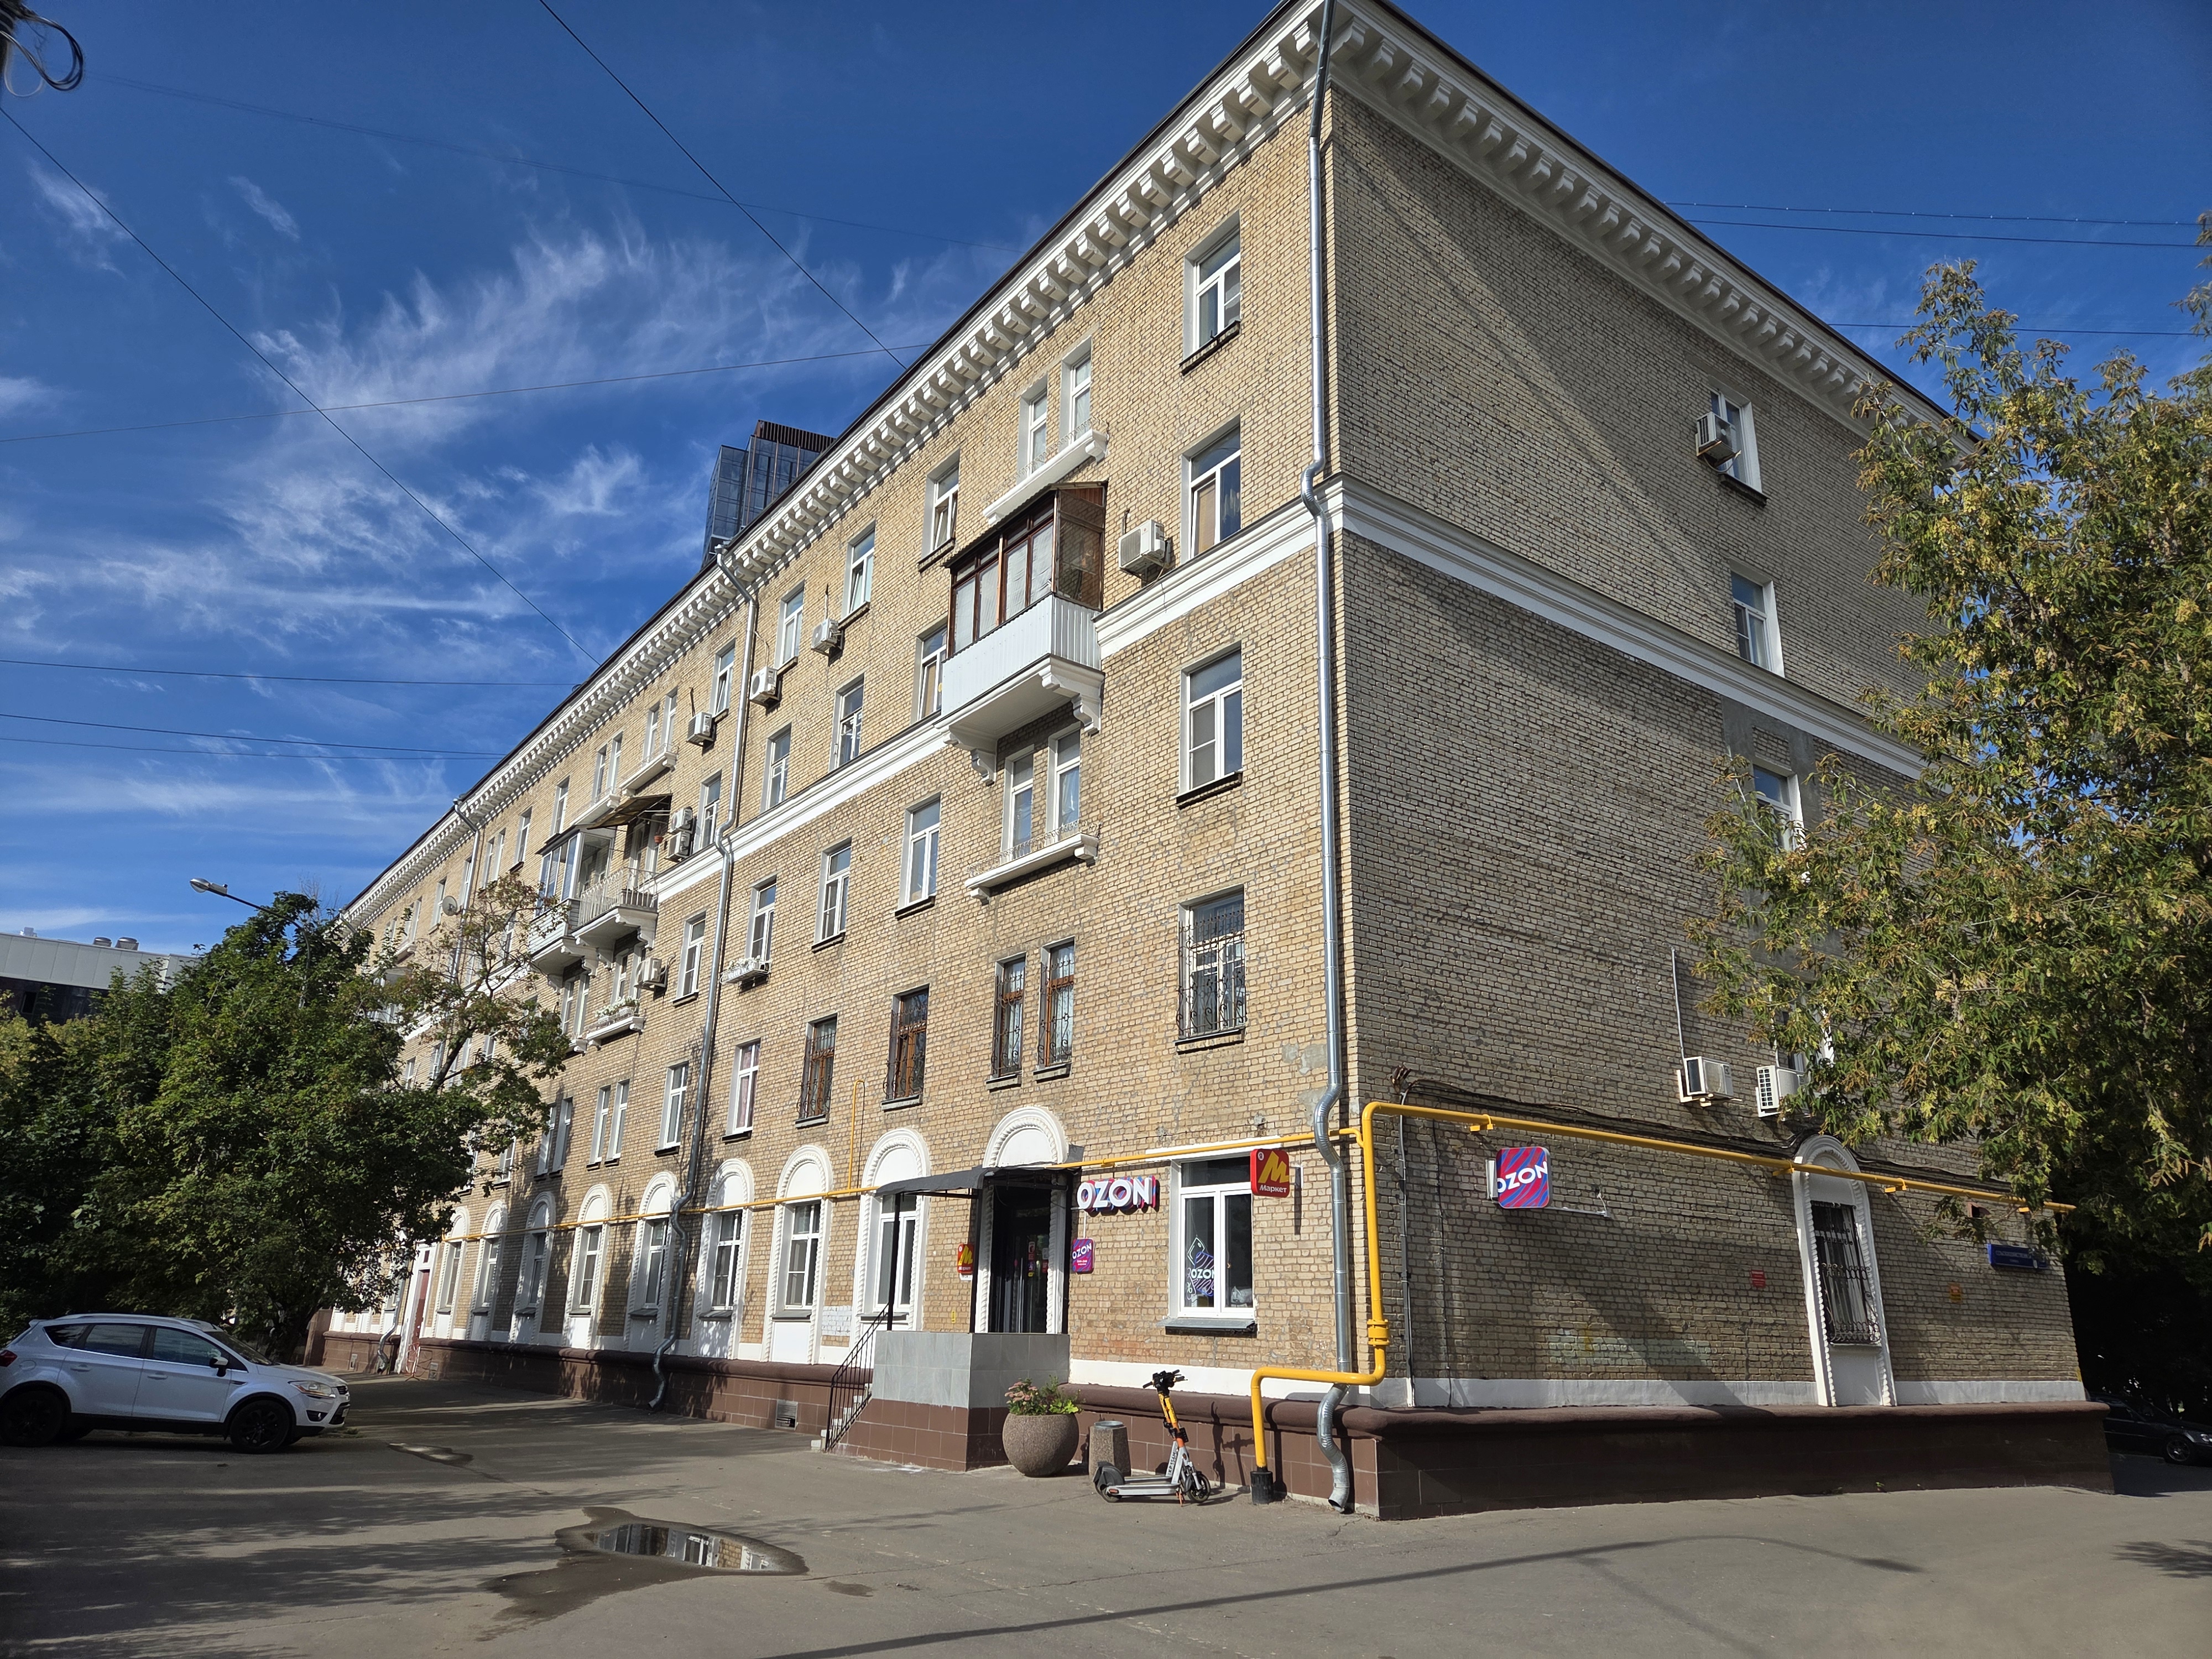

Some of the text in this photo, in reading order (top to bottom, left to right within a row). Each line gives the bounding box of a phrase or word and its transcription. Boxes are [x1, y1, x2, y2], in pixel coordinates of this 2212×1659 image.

[1259, 1185, 1287, 1193] Маркет
[1497, 1161, 1547, 1193] OZON
[1077, 1177, 1152, 1209] OZON
[1072, 1243, 1092, 1259] OZON
